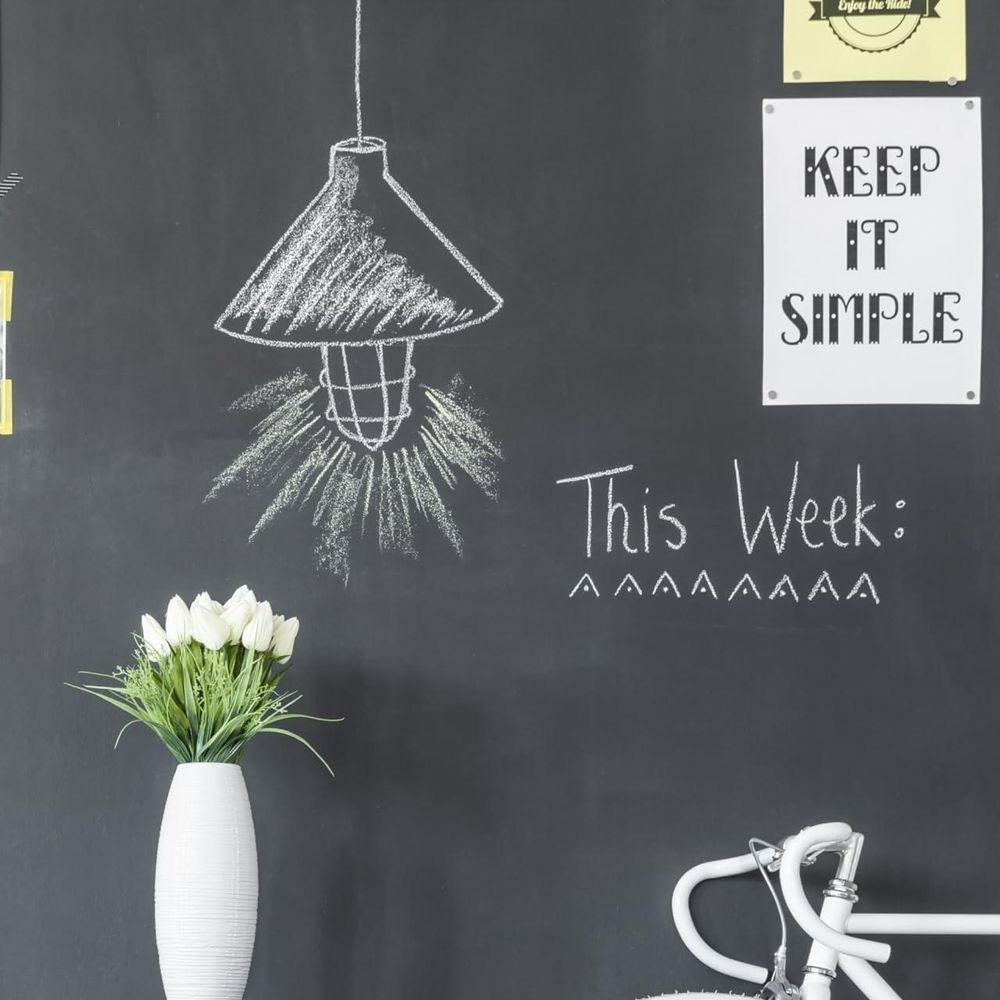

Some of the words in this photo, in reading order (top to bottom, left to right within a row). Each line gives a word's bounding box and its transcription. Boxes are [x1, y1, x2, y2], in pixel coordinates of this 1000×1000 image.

[838, 0, 865, 13] Enjoy
[868, 0, 884, 10] the
[804, 145, 941, 198] KEEP
[846, 219, 899, 271] IT
[781, 291, 964, 346] SIMPLE
[556, 464, 687, 558] This
[733, 458, 907, 555] Week:
